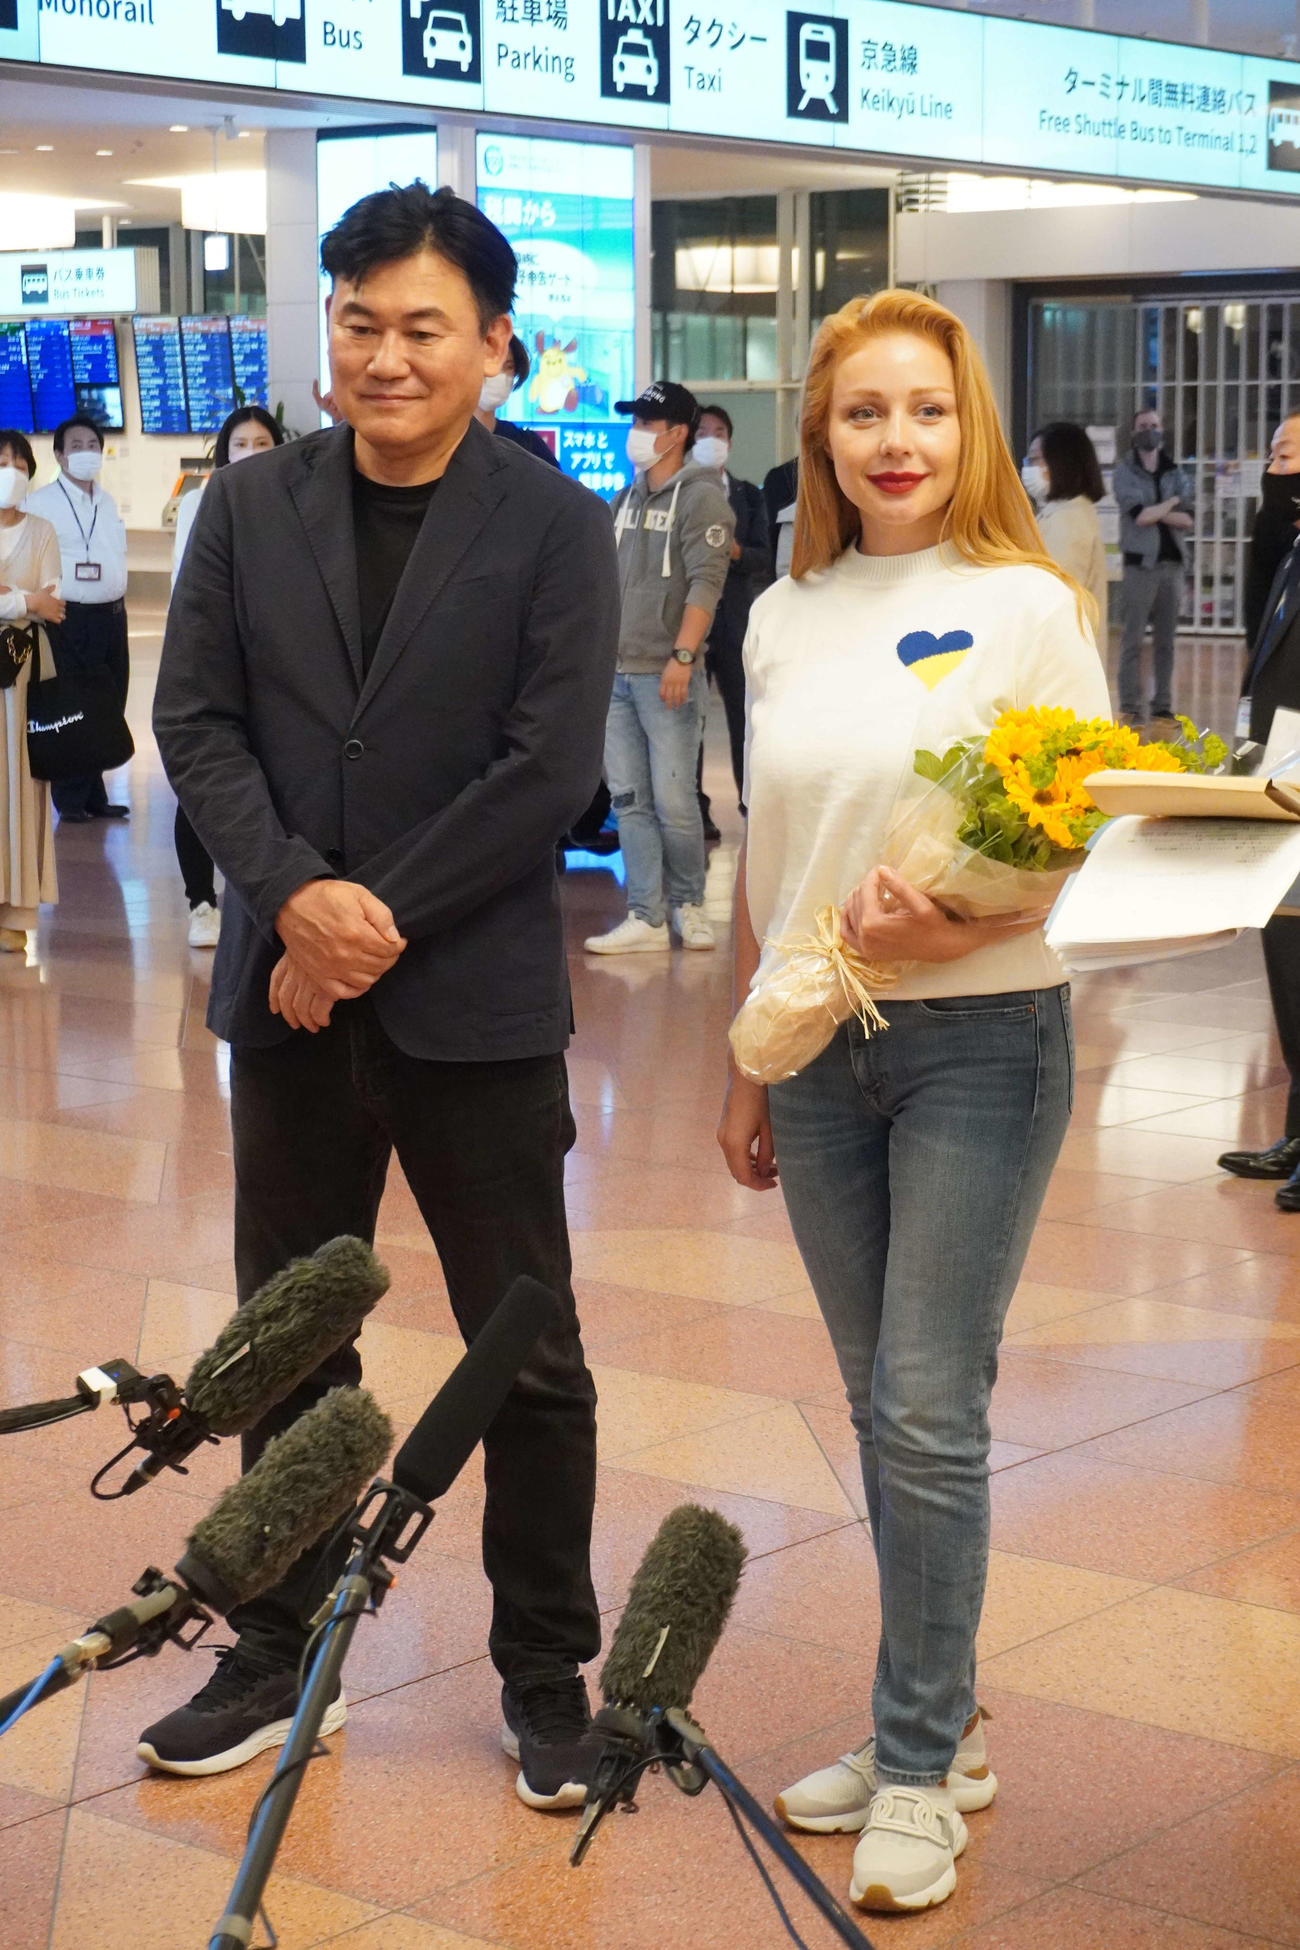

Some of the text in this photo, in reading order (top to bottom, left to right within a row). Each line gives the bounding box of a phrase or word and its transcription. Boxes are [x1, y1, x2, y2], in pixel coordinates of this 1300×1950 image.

[496, 0, 568, 31] 駐車場
[323, 20, 363, 50] Bus
[684, 15, 768, 50] タクシー
[496, 43, 575, 82] Parking
[860, 39, 919, 77] 京急線
[684, 66, 723, 94] Taxi
[1063, 66, 1256, 116] ターミナル間無料連絡バス
[860, 88, 953, 120] Keikyū Line
[1039, 109, 1071, 134] Free
[1074, 113, 1126, 141] Shuttle
[1130, 121, 1155, 143] Bus
[1158, 125, 1172, 145] to
[1177, 126, 1234, 152] Terminal
[563, 430, 609, 449] スマホと
